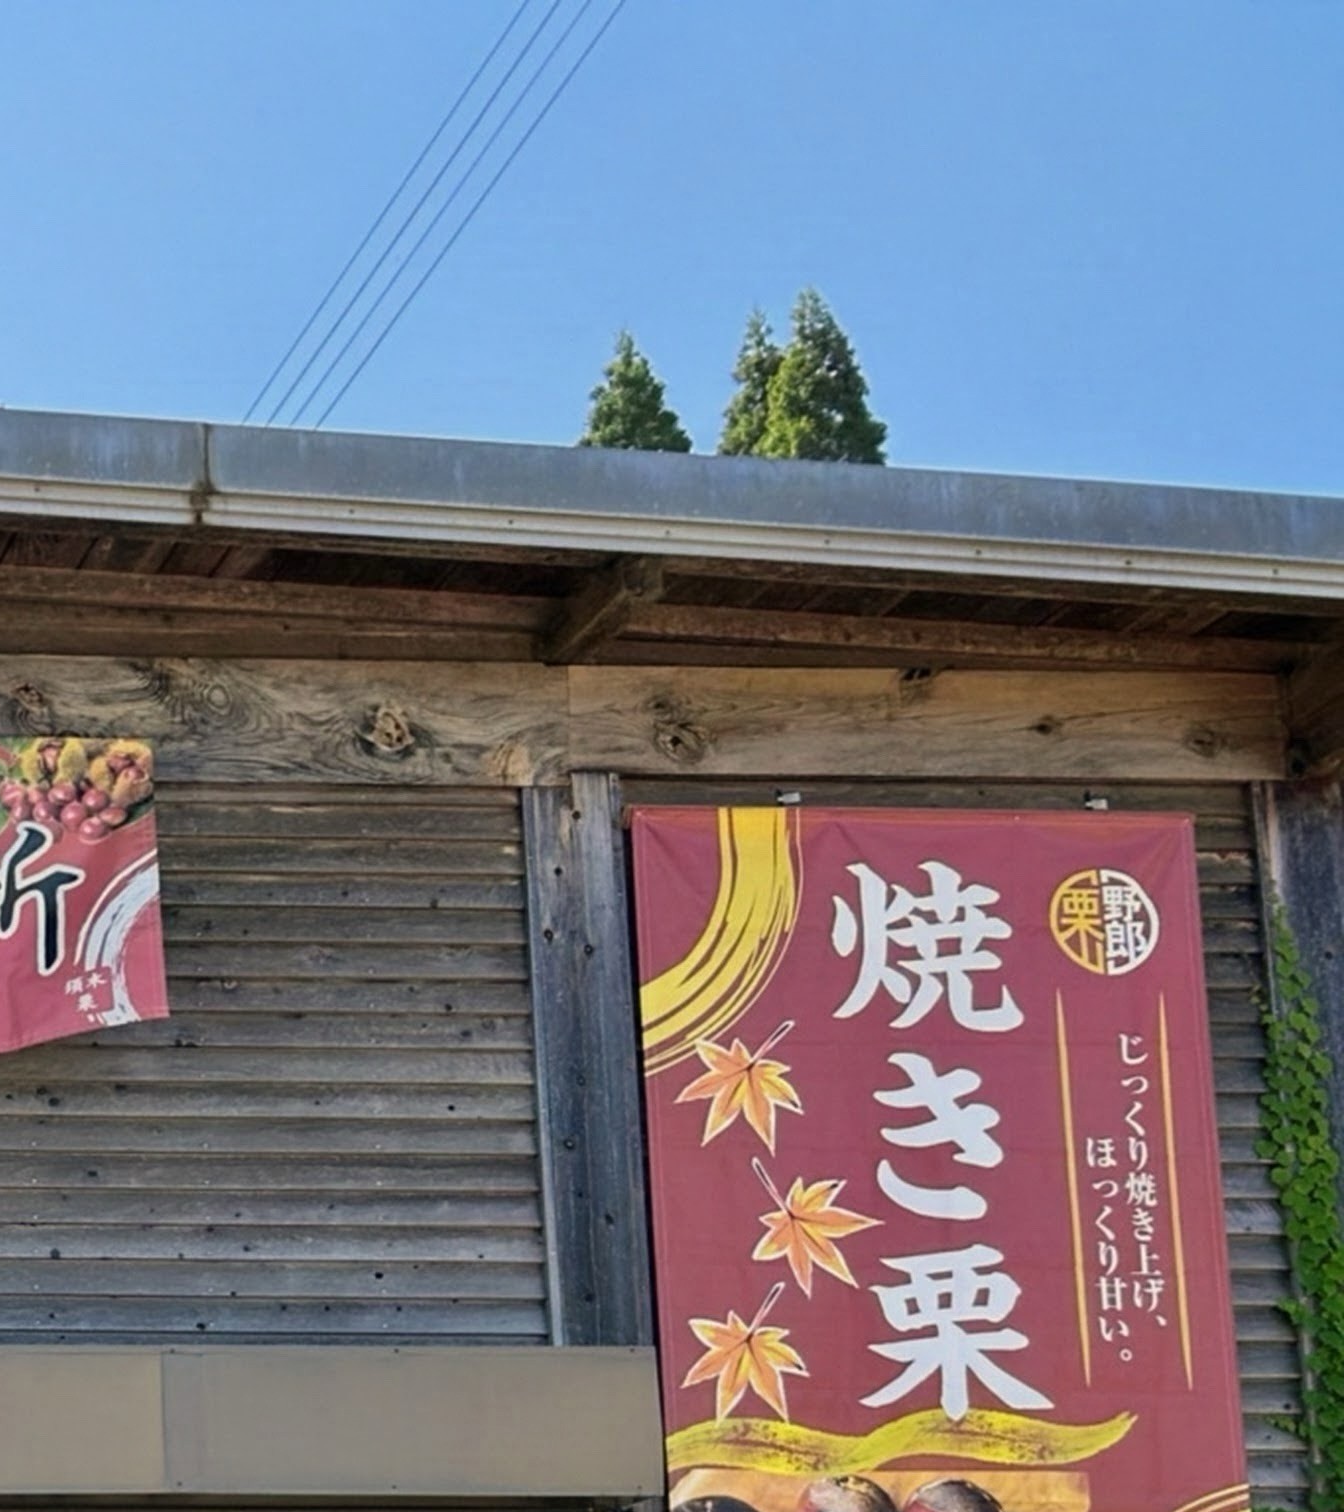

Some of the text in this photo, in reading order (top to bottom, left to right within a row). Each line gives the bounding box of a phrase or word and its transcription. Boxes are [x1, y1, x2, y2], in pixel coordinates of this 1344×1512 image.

[830, 861, 1055, 1421] 焼き栗
[1086, 1136, 1134, 1361] ほっくり甘い。
[1118, 1032, 1167, 1327] じっくり焼き上げ、
